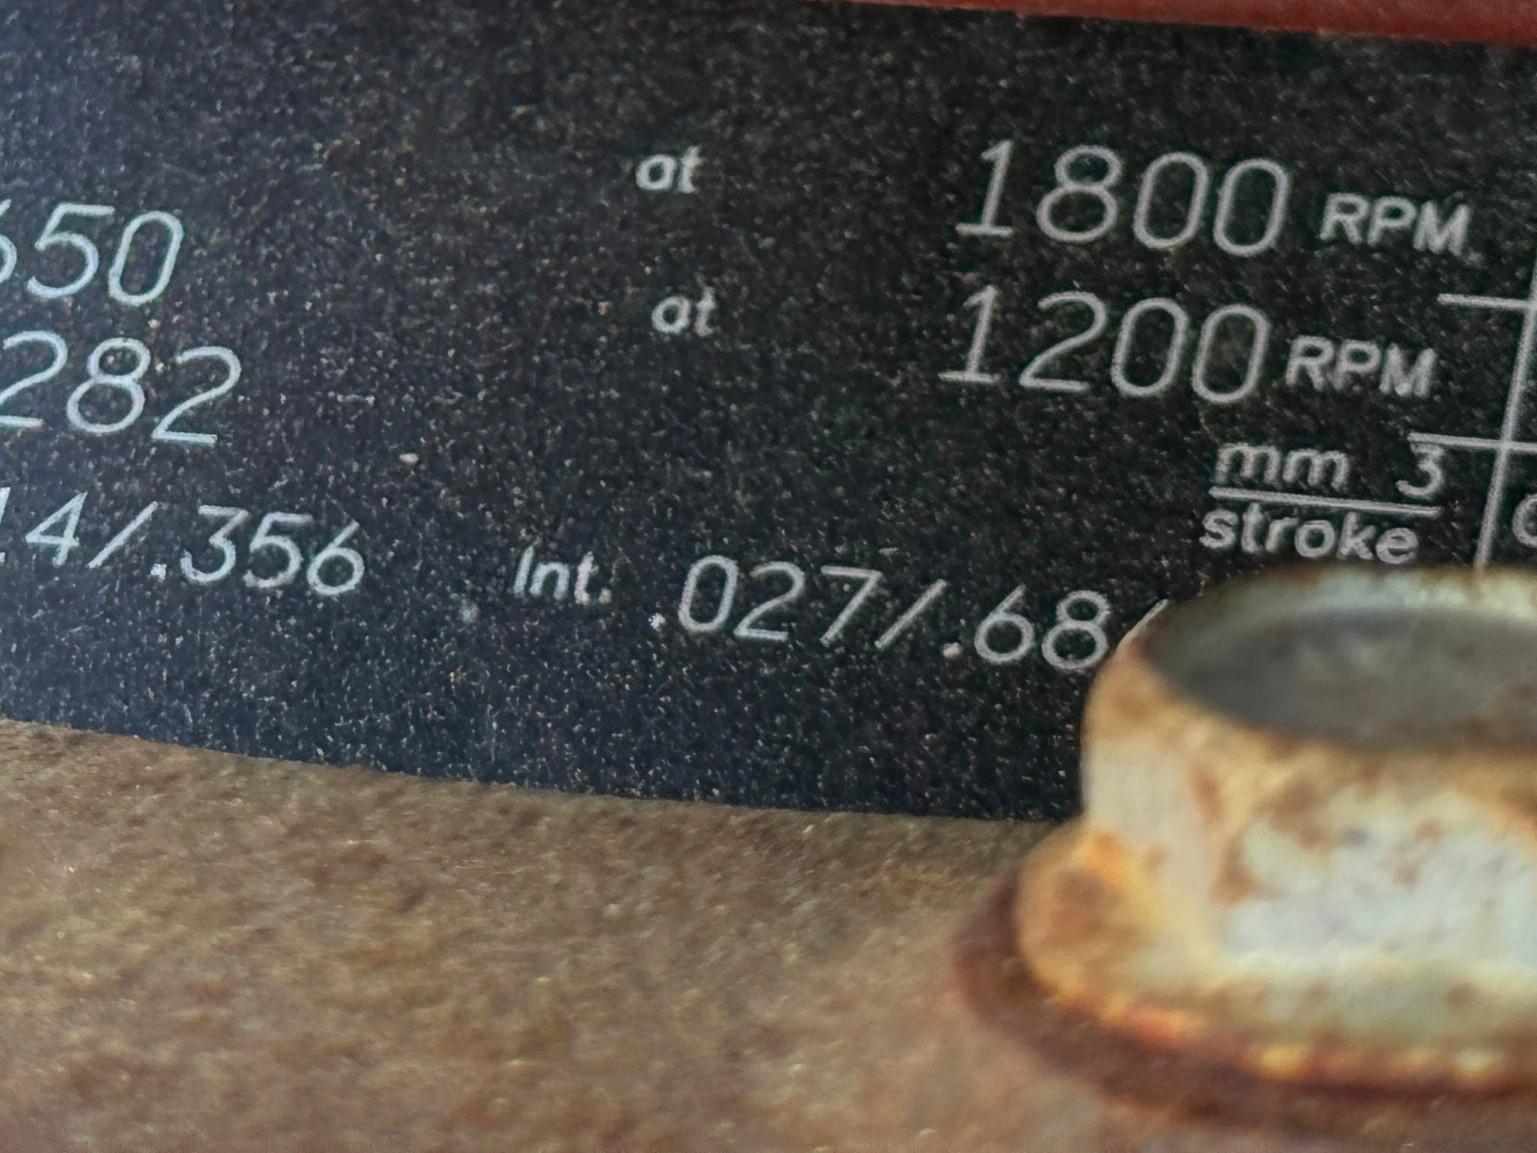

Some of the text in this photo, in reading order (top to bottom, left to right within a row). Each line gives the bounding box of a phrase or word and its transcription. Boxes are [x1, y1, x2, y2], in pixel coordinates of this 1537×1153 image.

[635, 146, 704, 195] at
[955, 139, 1291, 257] 1800
[1319, 191, 1471, 255] RPM
[651, 286, 717, 337] at
[938, 284, 1270, 404] 1200
[1284, 335, 1437, 398] RPM
[1214, 441, 1350, 491] mm
[1395, 440, 1444, 498] 3
[1199, 501, 1420, 566] stroke
[512, 546, 612, 605] Int.
[650, 554, 1168, 674] .027/.68
